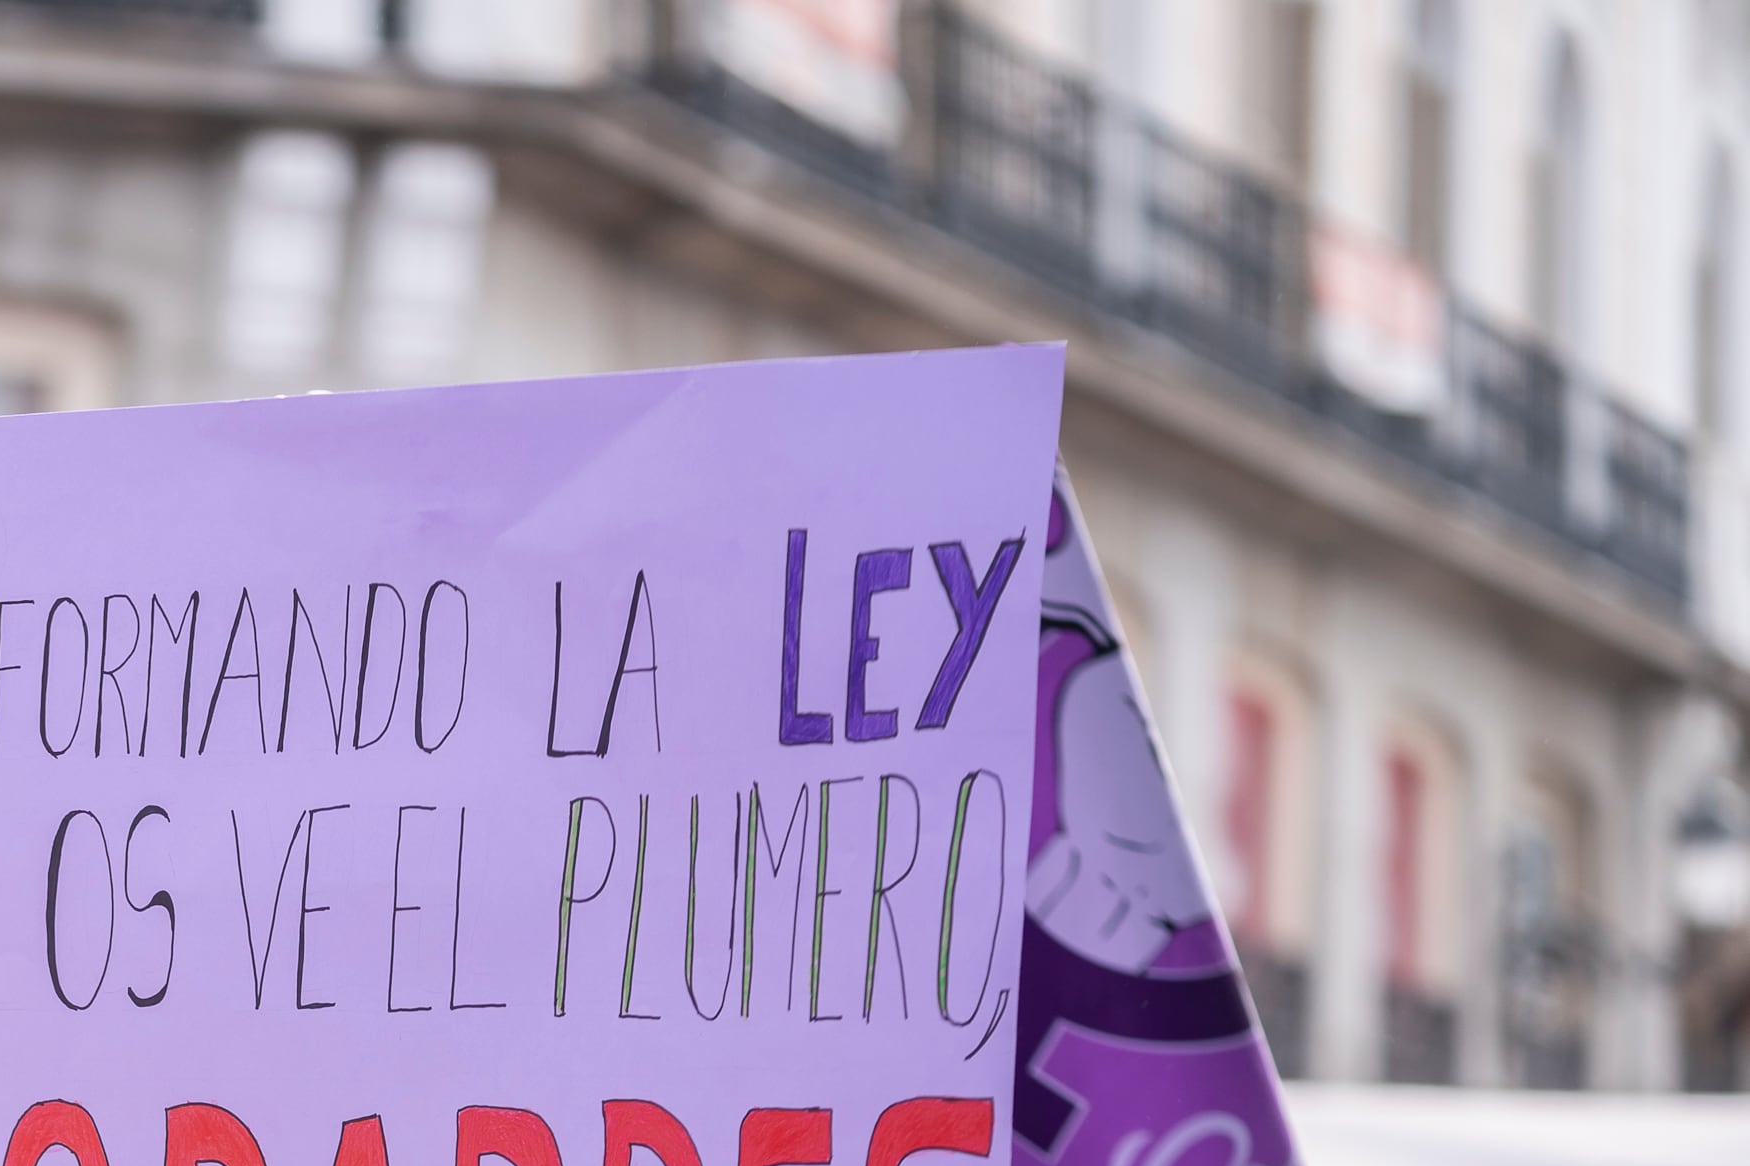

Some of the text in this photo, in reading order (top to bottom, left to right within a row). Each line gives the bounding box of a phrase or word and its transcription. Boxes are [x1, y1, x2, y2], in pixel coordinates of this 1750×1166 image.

[546, 569, 662, 758] LA
[778, 526, 1027, 746] LEY
[45, 803, 178, 1012] OS
[230, 803, 352, 1012] VE
[386, 805, 508, 1013] EL
[553, 768, 1012, 1062] PLUMERO,
